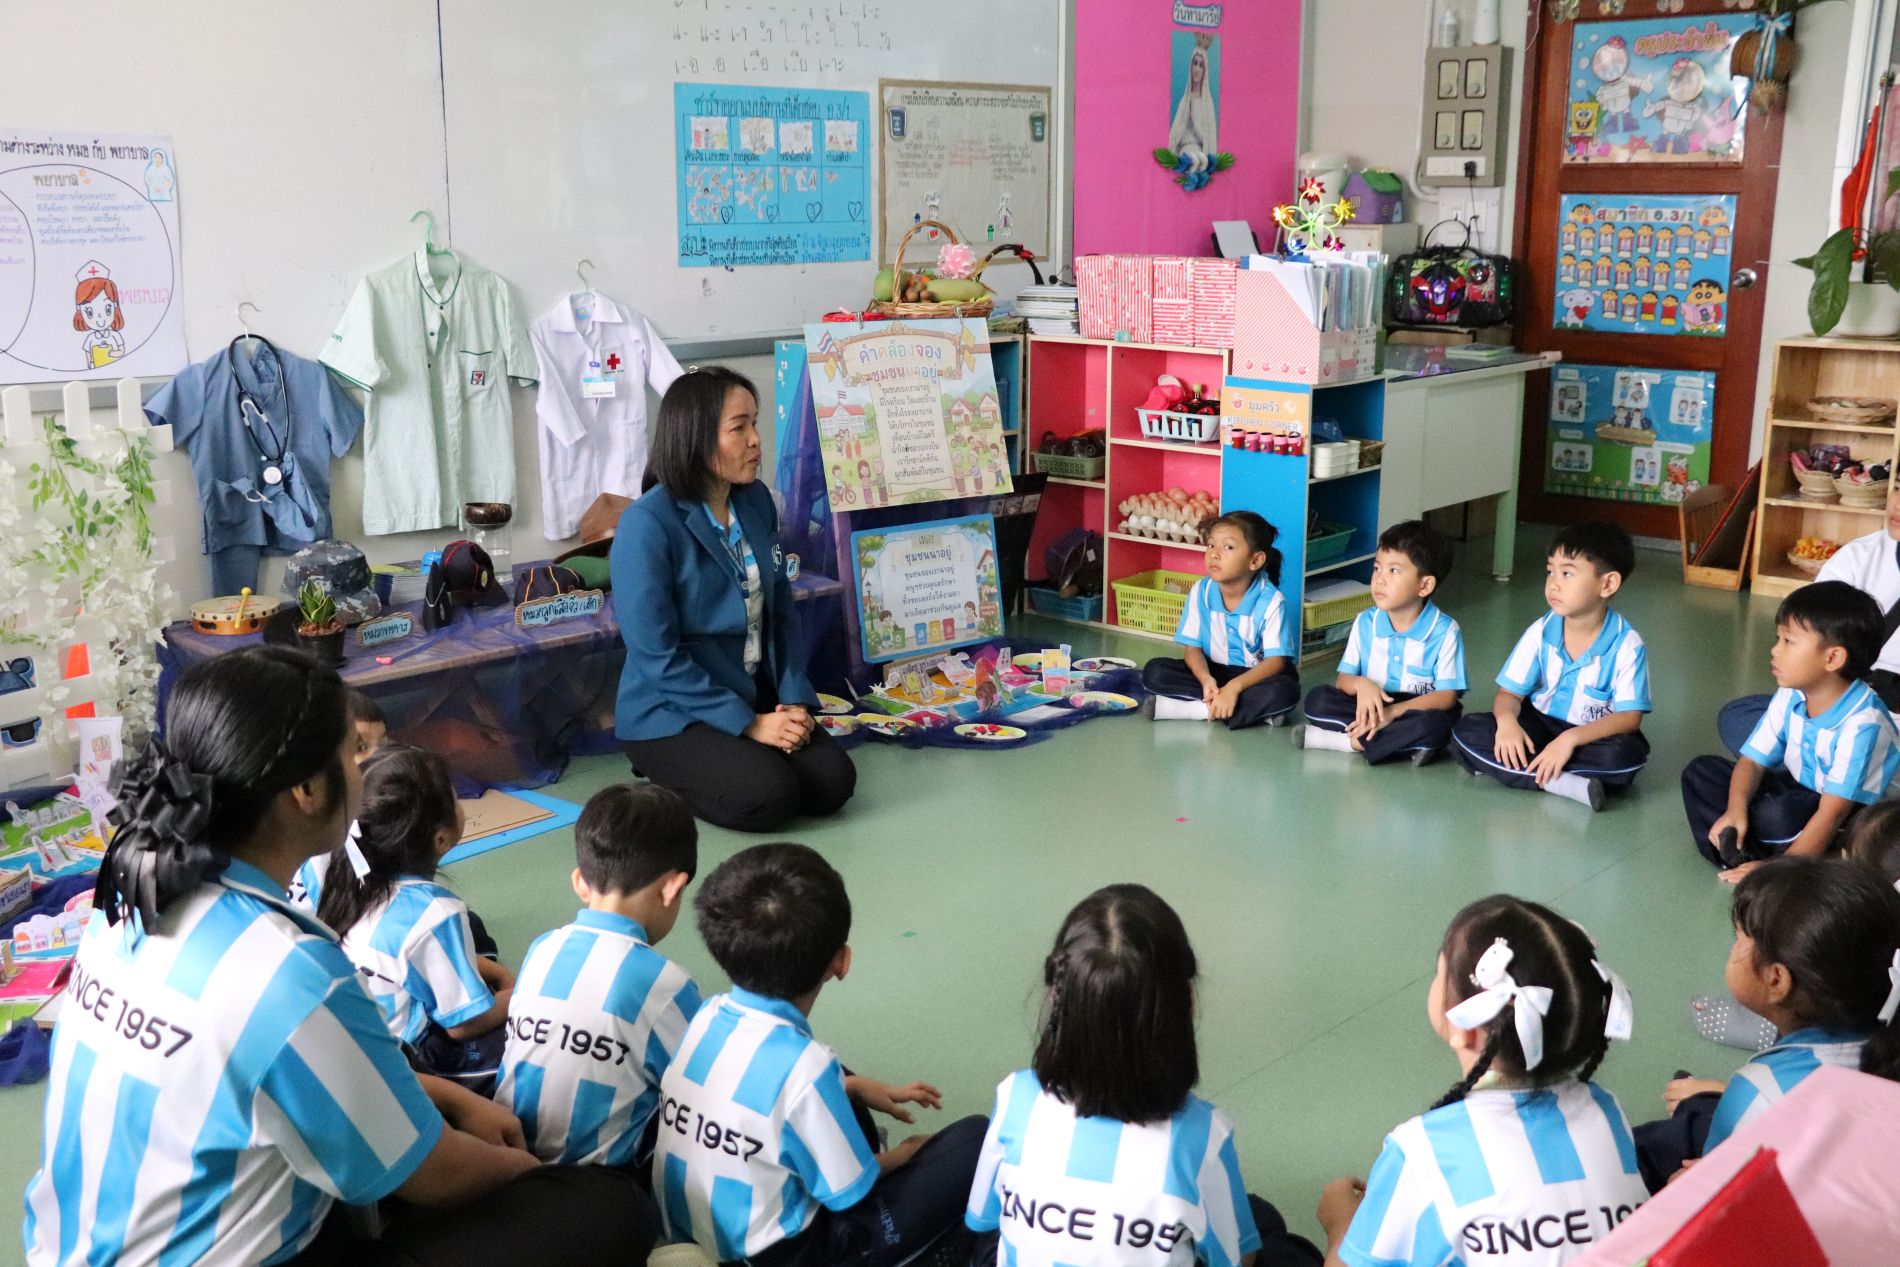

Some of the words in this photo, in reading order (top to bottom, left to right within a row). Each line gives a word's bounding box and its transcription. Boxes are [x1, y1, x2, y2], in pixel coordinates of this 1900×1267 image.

[109, 145, 150, 161] พยาบาล
[859, 339, 943, 364] คำคล้องจอง
[1248, 400, 1281, 414] มุมครัว
[115, 998, 193, 1058] 1957
[560, 1023, 631, 1066] 1957
[695, 1112, 764, 1162] 1957
[1462, 1209, 1593, 1255] SINCE
